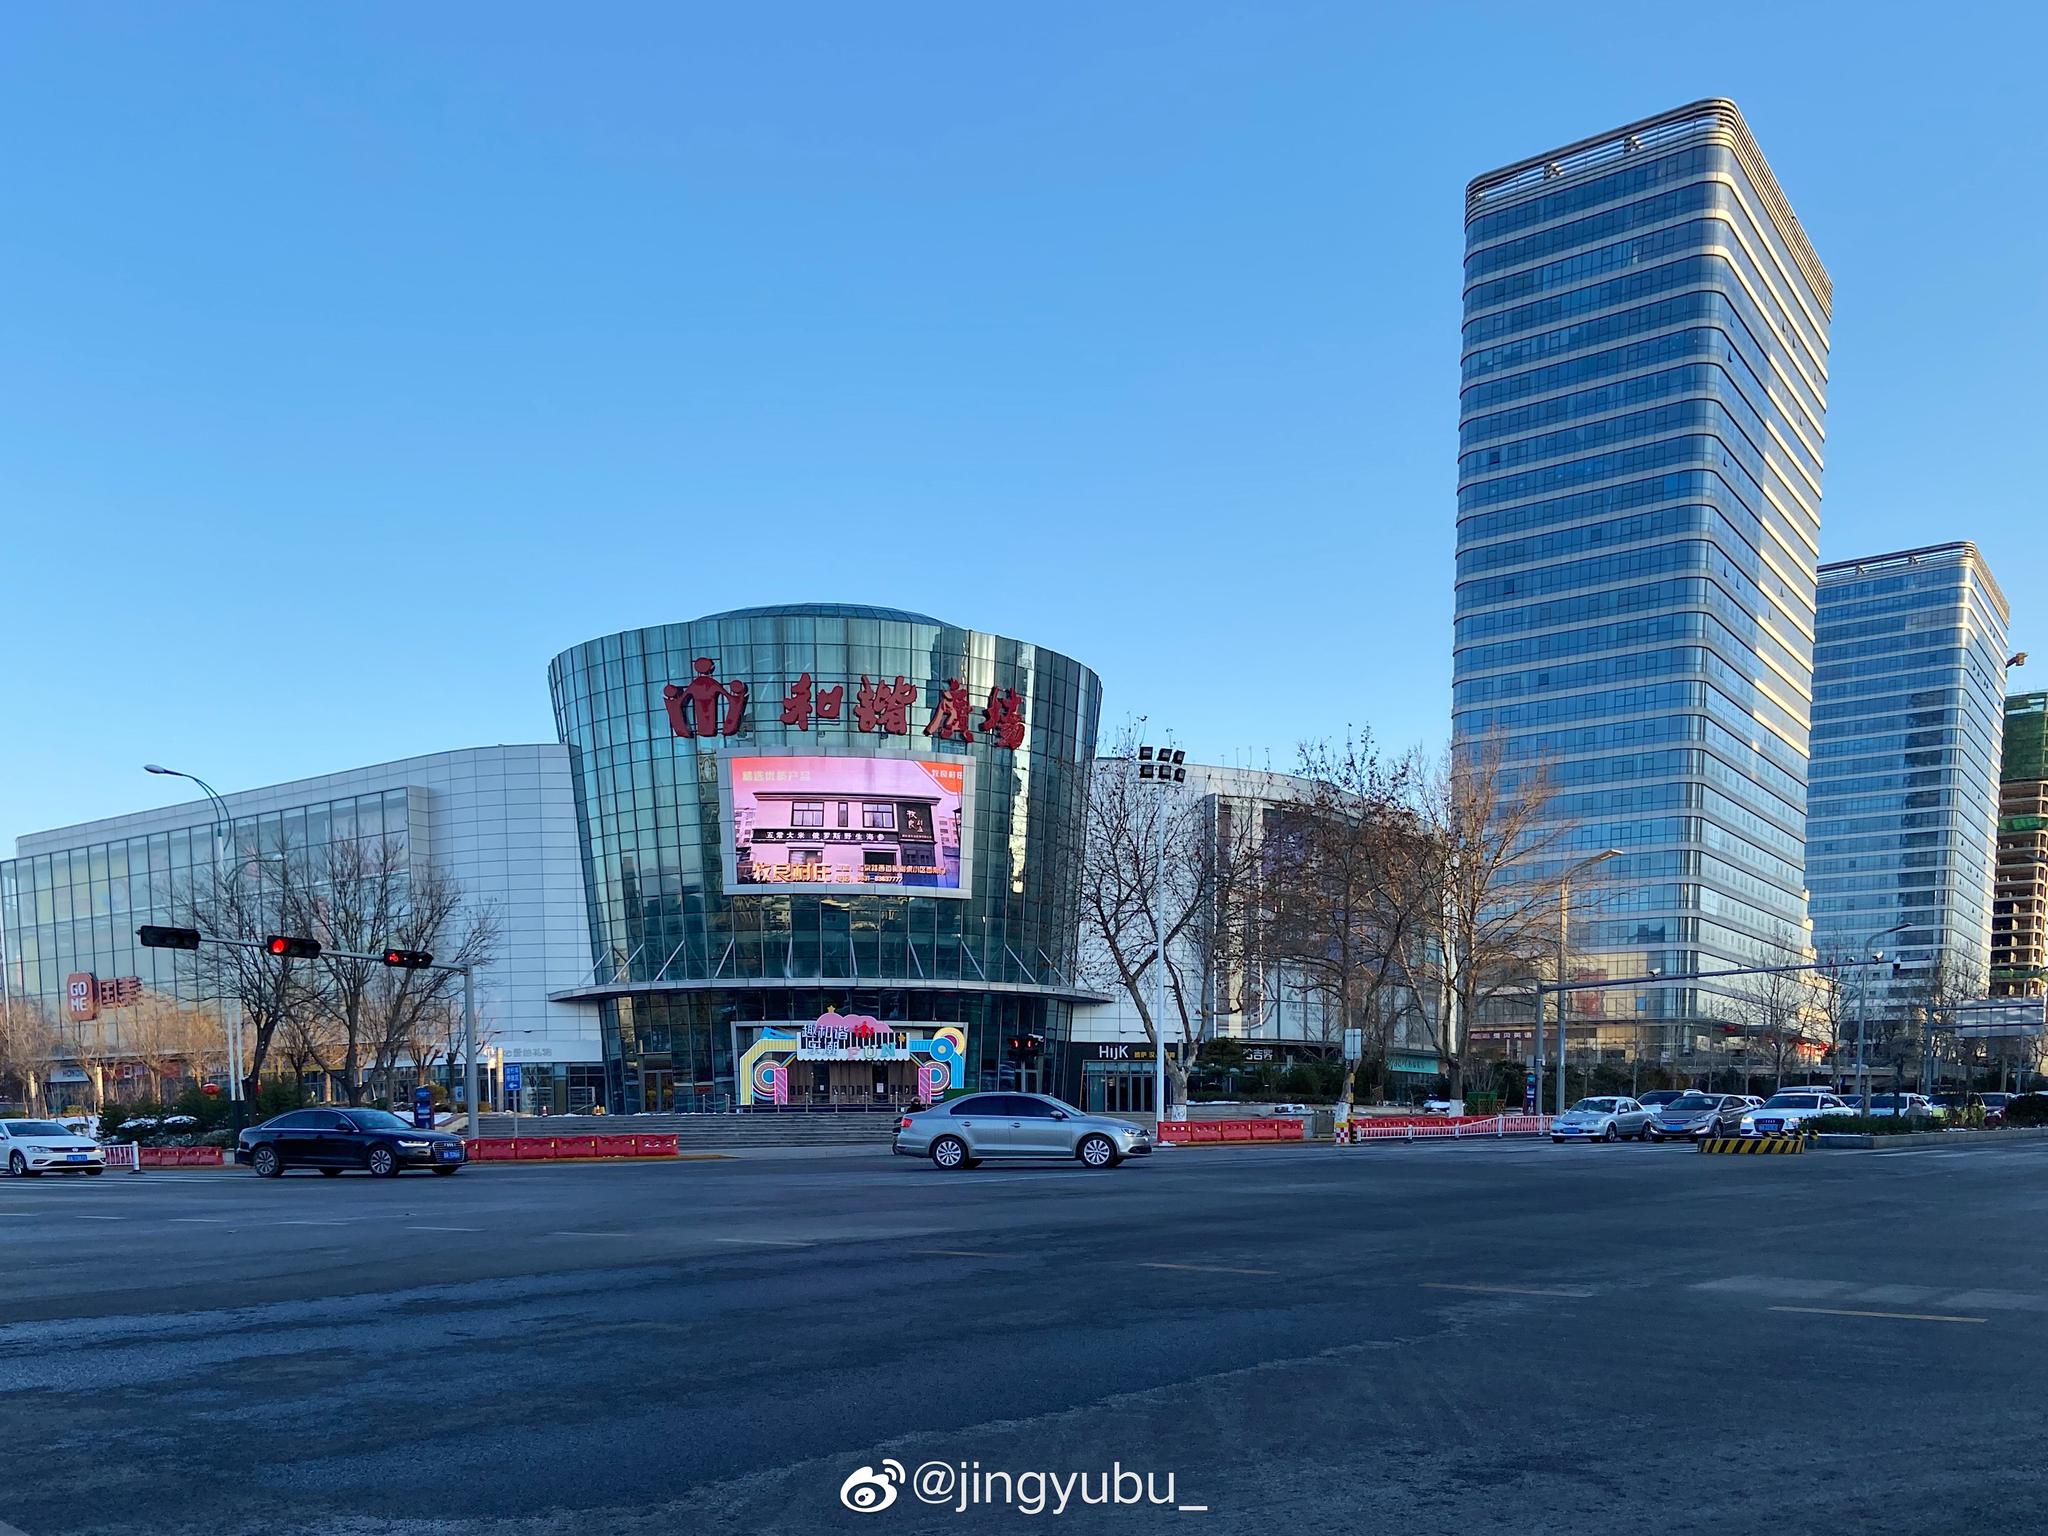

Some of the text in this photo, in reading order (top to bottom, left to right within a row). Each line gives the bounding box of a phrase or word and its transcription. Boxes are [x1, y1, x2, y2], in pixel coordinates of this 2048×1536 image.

[70, 981, 88, 997] GO
[99, 975, 144, 1009] 国美
[71, 997, 89, 1012] ME
[801, 1024, 849, 1040] 趣和谐
[847, 1042, 897, 1060] FUN
